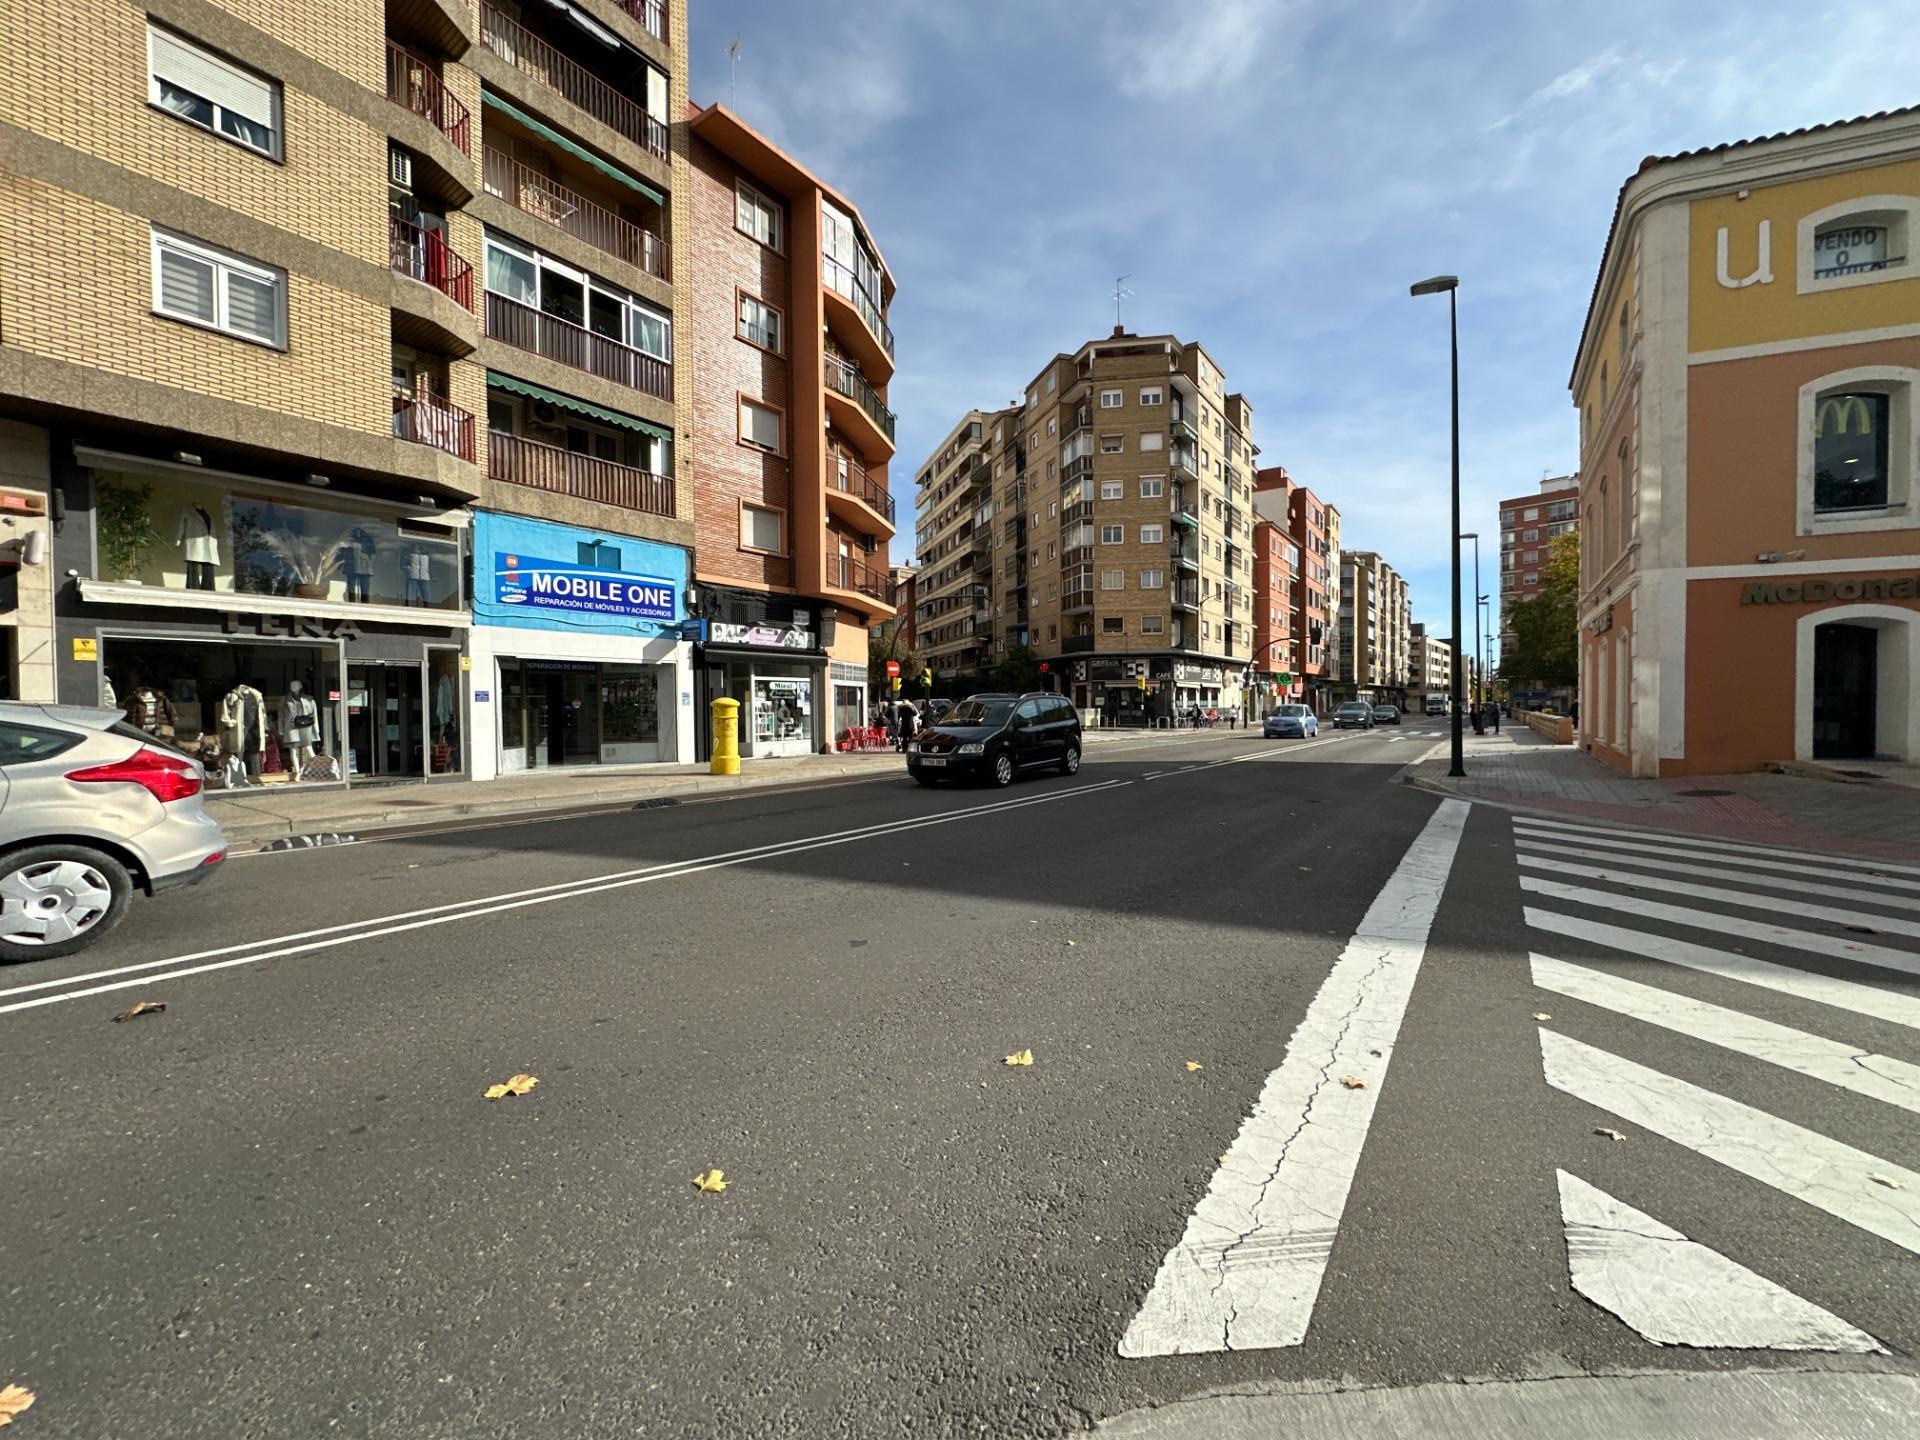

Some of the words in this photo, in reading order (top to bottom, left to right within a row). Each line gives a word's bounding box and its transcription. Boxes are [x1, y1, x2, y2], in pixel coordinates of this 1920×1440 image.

[1815, 229, 1877, 251] VENDO
[1836, 250, 1849, 266] O
[532, 572, 623, 602] MOBILE
[628, 585, 672, 608] ONE
[1739, 574, 1920, 606] McDona
[534, 596, 583, 609] REPARACIÓN
[595, 602, 625, 612] MÓVILES
[631, 607, 672, 618] ACCESORIOS
